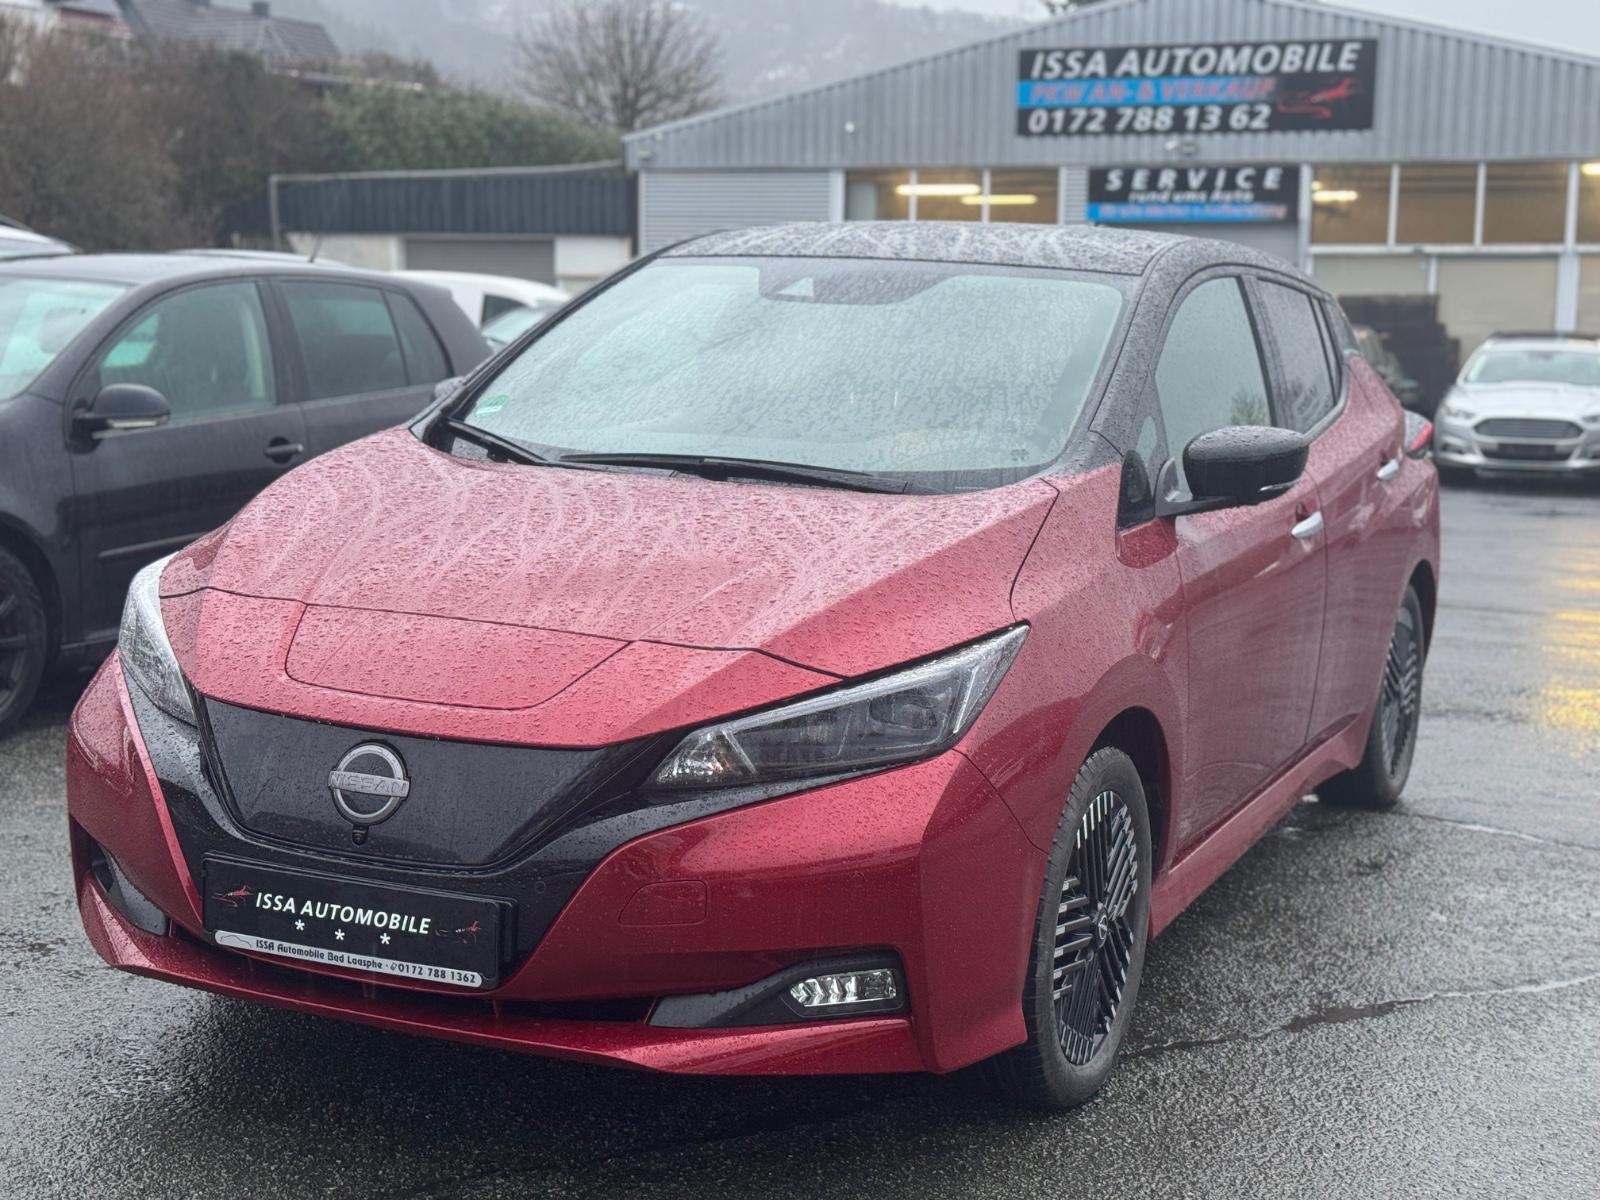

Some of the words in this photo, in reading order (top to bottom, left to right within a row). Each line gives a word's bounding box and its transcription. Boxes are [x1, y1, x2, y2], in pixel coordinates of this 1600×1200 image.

[1031, 51, 1106, 79] ISSA
[1116, 42, 1361, 78] AUTOMOBILE
[1161, 77, 1277, 100] VERKAUF
[1028, 108, 1105, 133] 0172
[1115, 106, 1174, 132] 788
[1183, 105, 1221, 131] 13
[1229, 103, 1271, 130] 62
[1105, 167, 1283, 191] SERVICE
[255, 892, 296, 914] ISSA
[300, 899, 432, 935] AUTOMOBILE
[256, 939, 275, 951] ISSA
[277, 944, 325, 960] Automobile
[327, 952, 345, 963] Bad
[348, 954, 383, 971] Laasphe
[398, 963, 424, 976] 0172
[427, 968, 447, 980] 788
[450, 971, 476, 984] 1362
